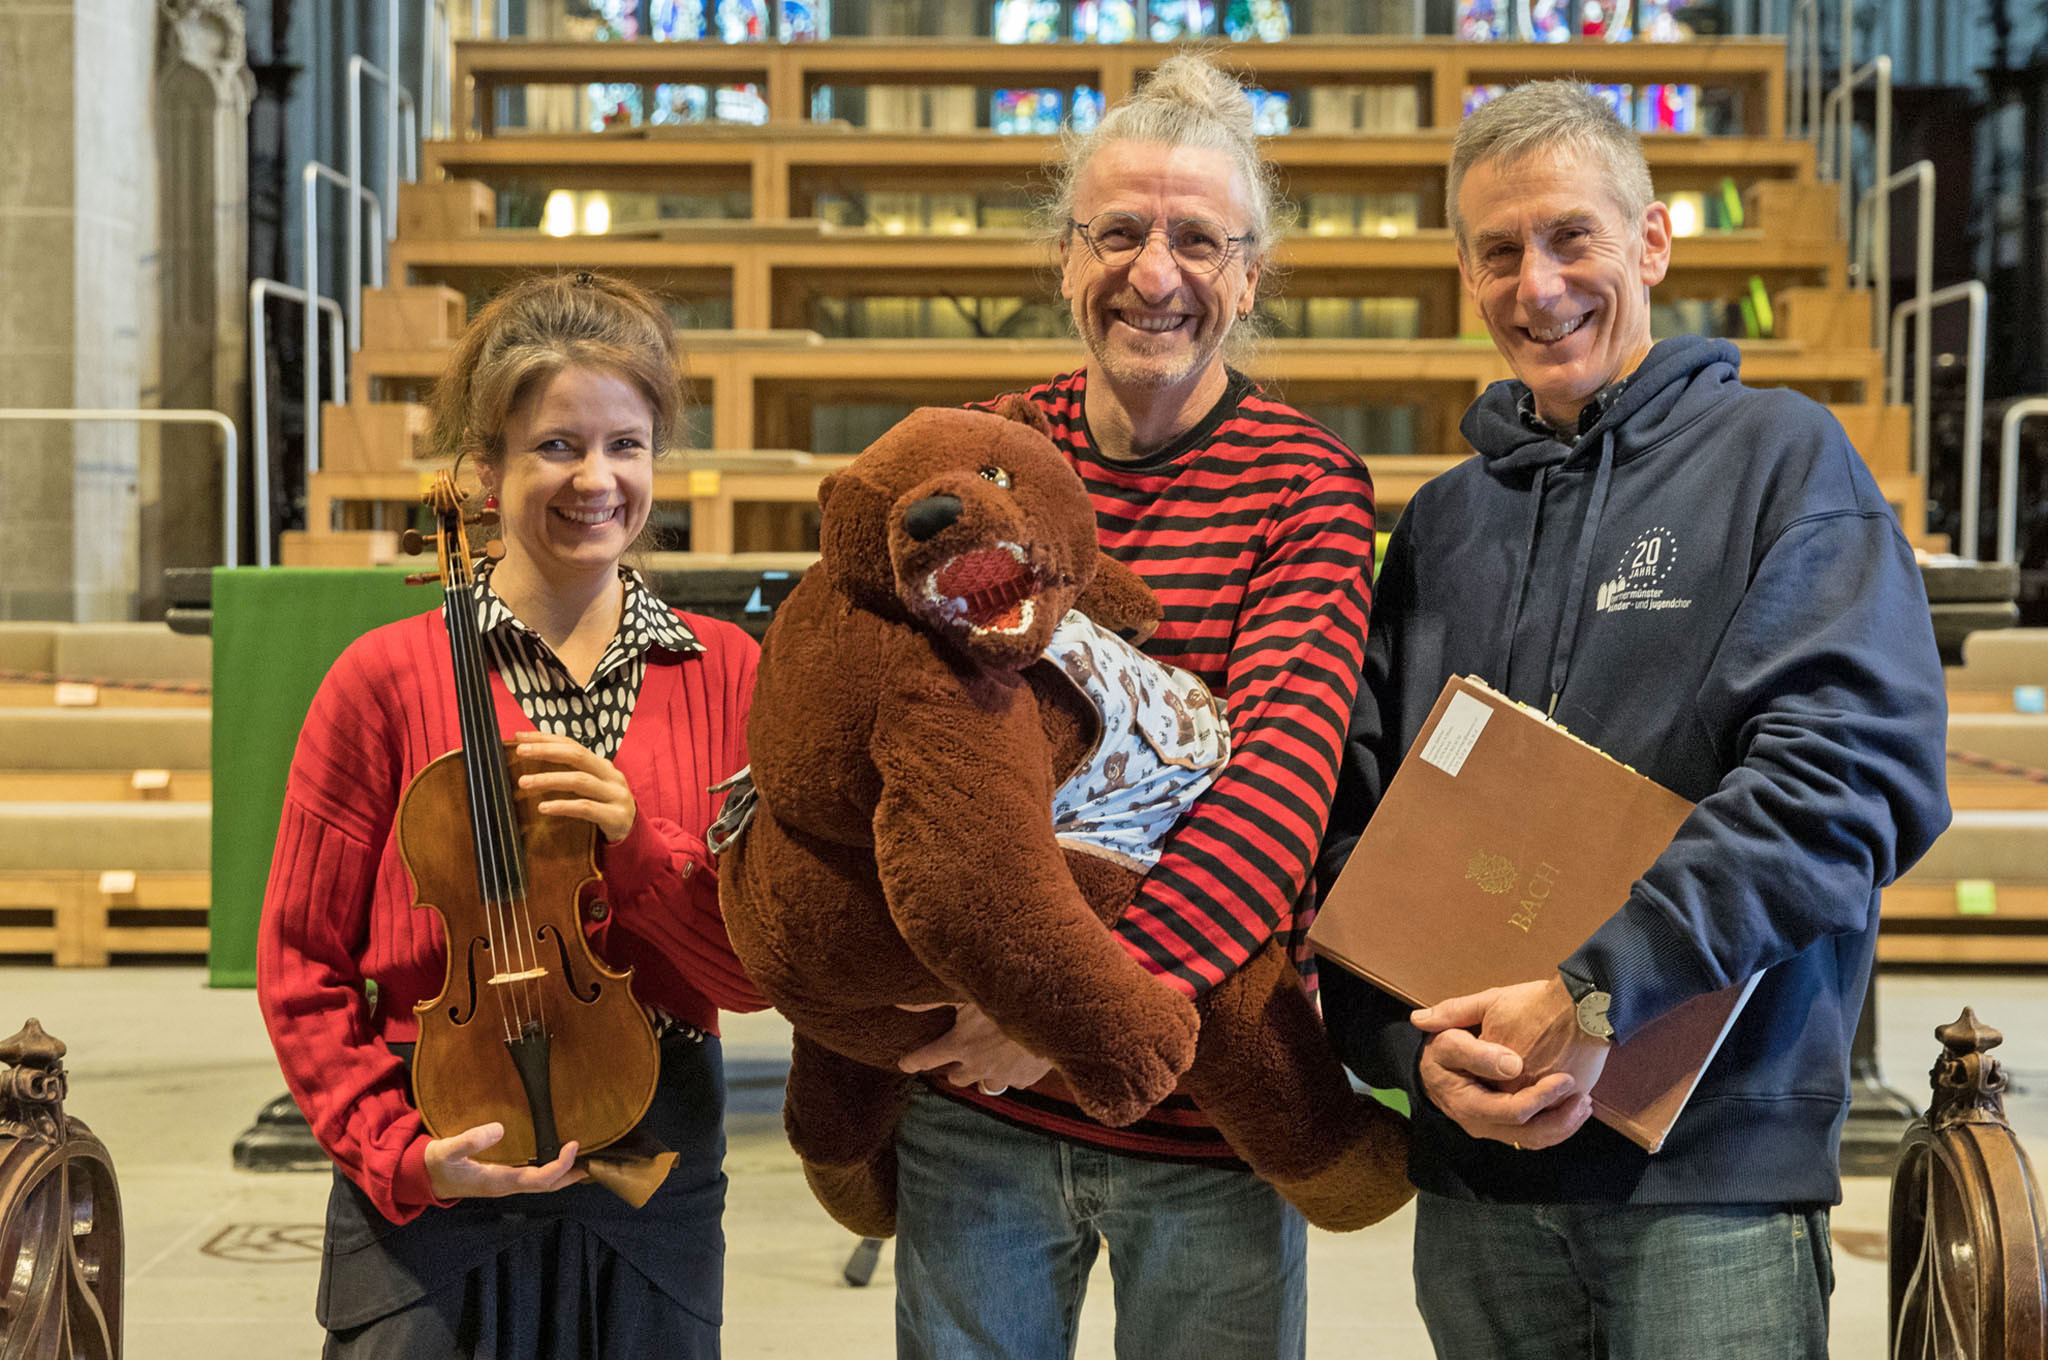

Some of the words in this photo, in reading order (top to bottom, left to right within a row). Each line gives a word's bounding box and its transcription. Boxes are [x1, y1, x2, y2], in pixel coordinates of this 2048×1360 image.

[1631, 536, 1662, 569] 20
[1628, 564, 1657, 579] JAHRE
[1635, 599, 1650, 610] und
[1648, 597, 1693, 611] jugendchor
[1508, 861, 1560, 933] BACH
